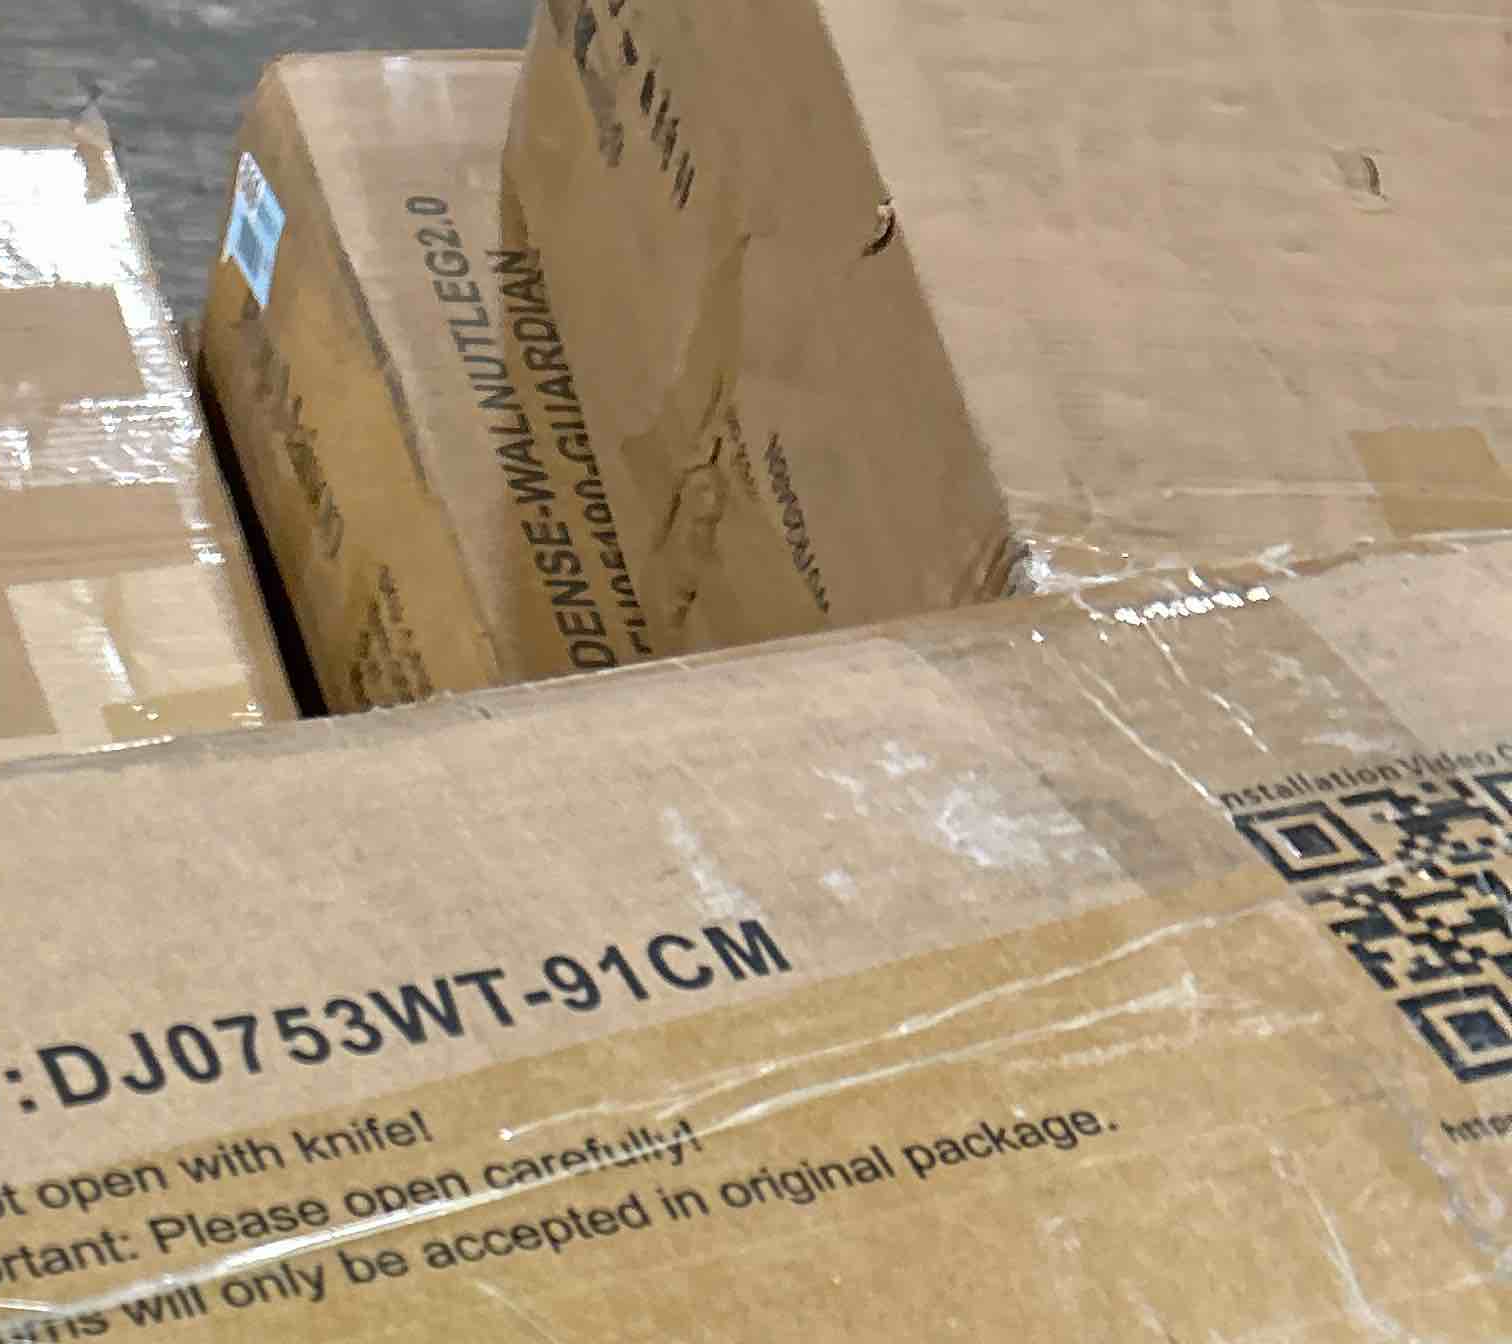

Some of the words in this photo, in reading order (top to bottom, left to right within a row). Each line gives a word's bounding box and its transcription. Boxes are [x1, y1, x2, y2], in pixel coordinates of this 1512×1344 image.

[1210, 763, 1400, 810] nstallation
[37, 1164, 168, 1212] open
[178, 1138, 285, 1183] with
[291, 1109, 433, 1163] knife!
[121, 1283, 207, 1326] will
[220, 1262, 326, 1307] only
[337, 1248, 409, 1285] be
[422, 1192, 651, 1269] accepted
[656, 1186, 711, 1221] in
[719, 1144, 896, 1209] original
[901, 1108, 1119, 1178] package.
[148, 1200, 330, 1254] Please
[344, 1170, 471, 1219] open
[484, 1118, 703, 1190] carefully!
